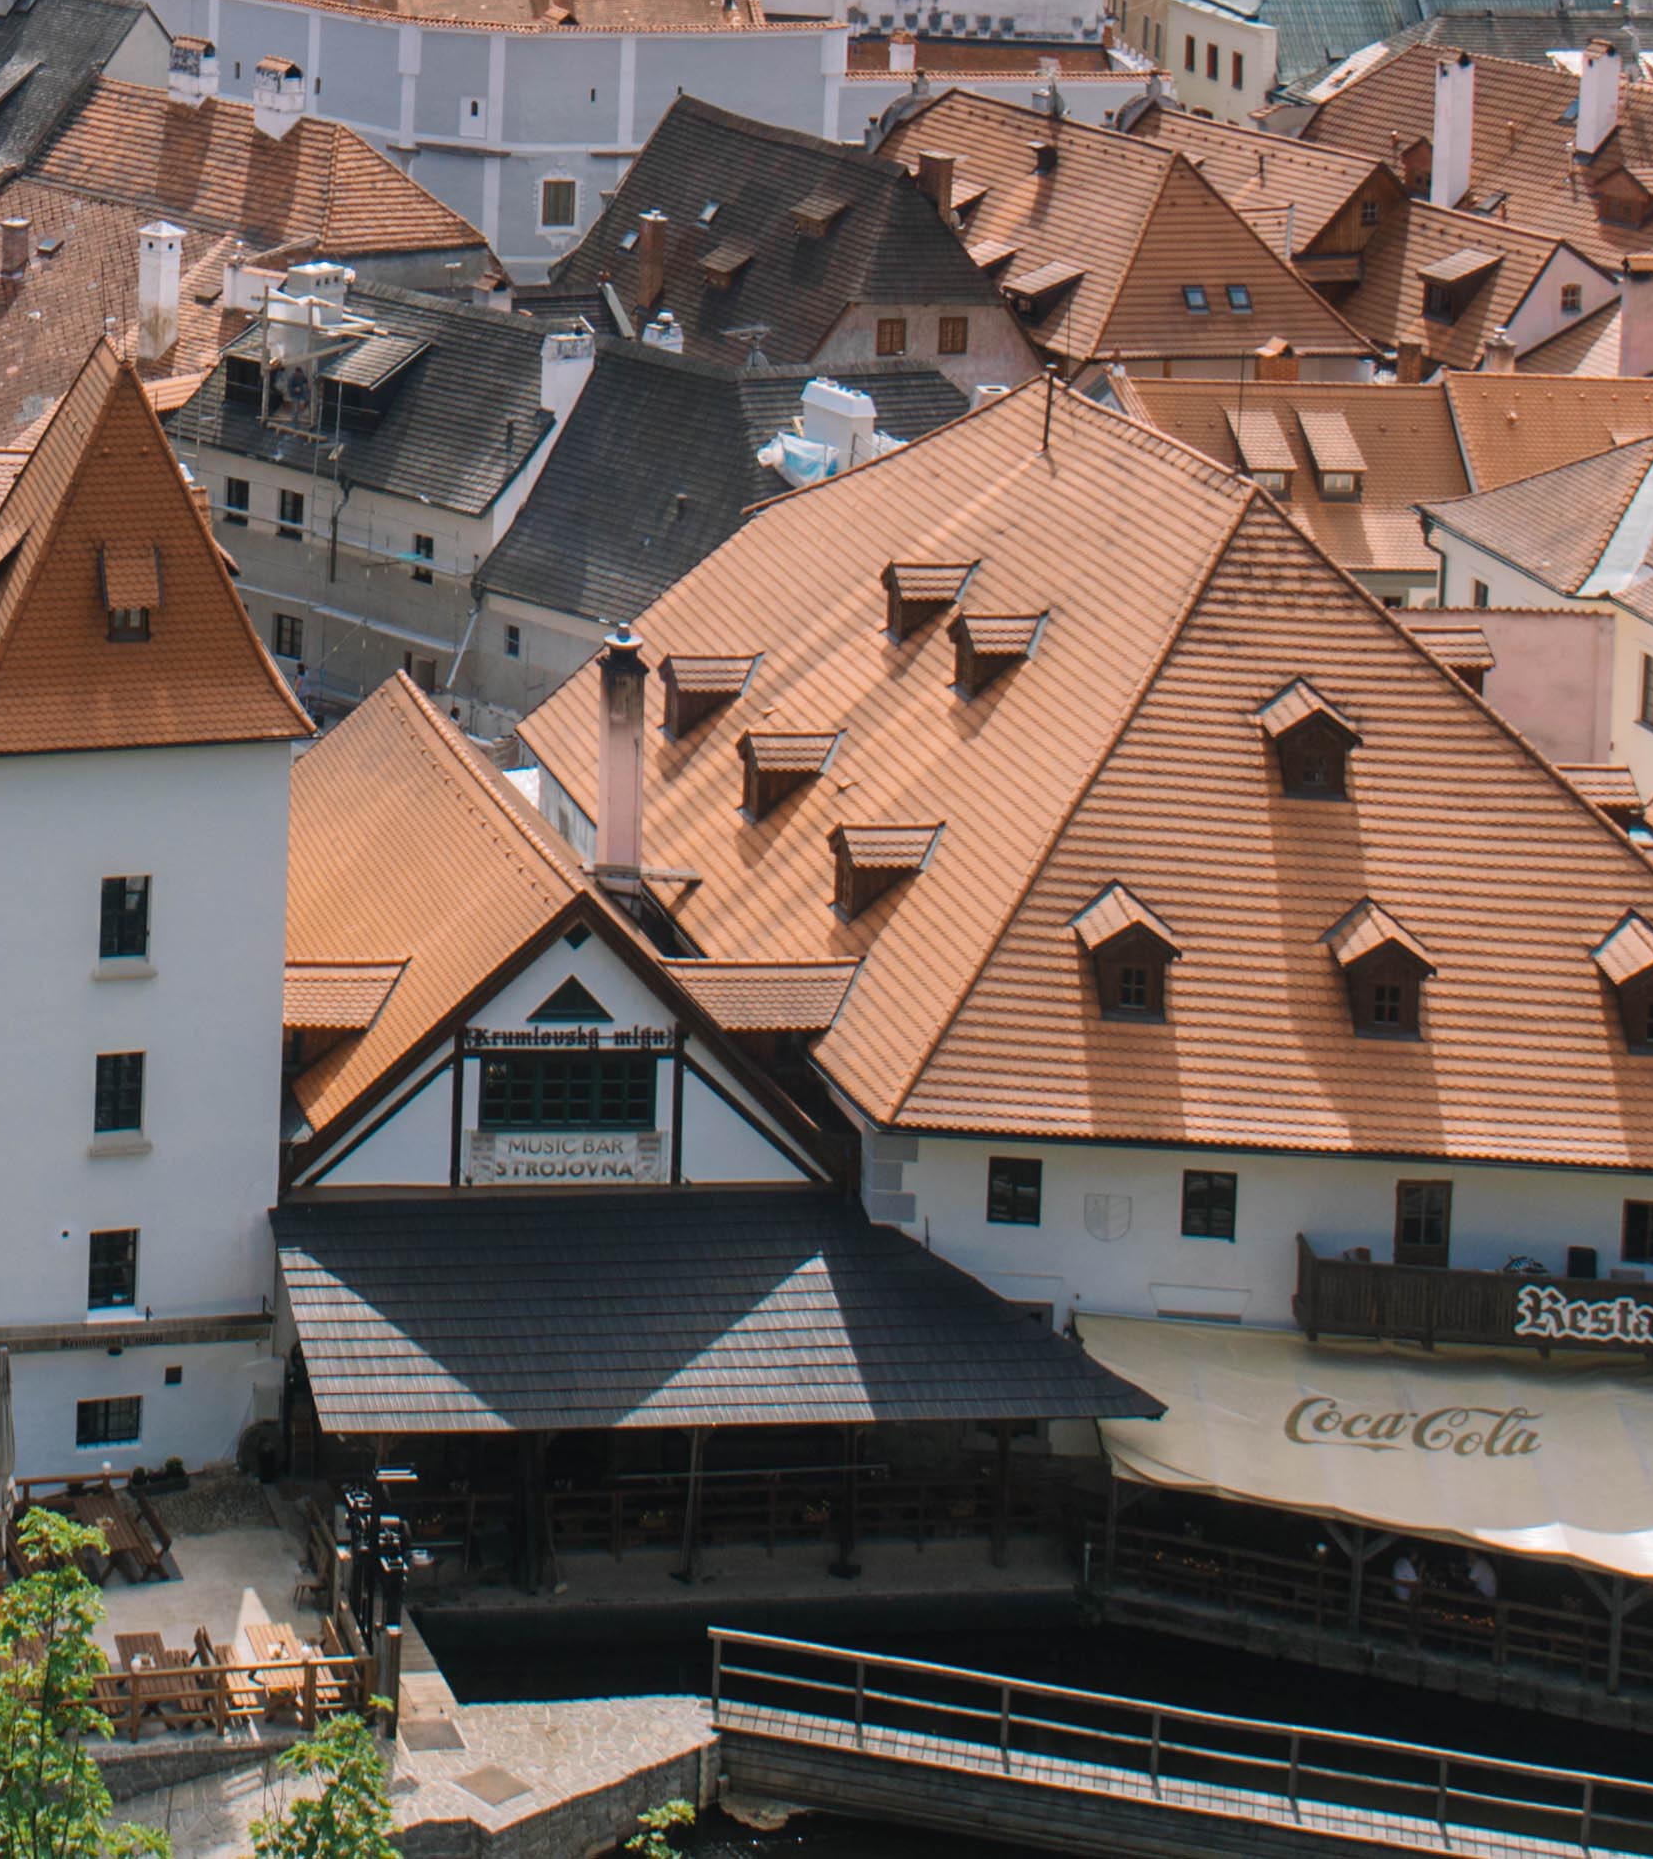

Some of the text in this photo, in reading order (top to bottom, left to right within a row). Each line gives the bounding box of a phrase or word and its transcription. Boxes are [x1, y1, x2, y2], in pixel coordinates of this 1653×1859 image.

[508, 1138, 624, 1155] MUSIC BAR
[496, 1160, 634, 1178] STROJOVNA
[1284, 1396, 1543, 1457] Coca-Cola
